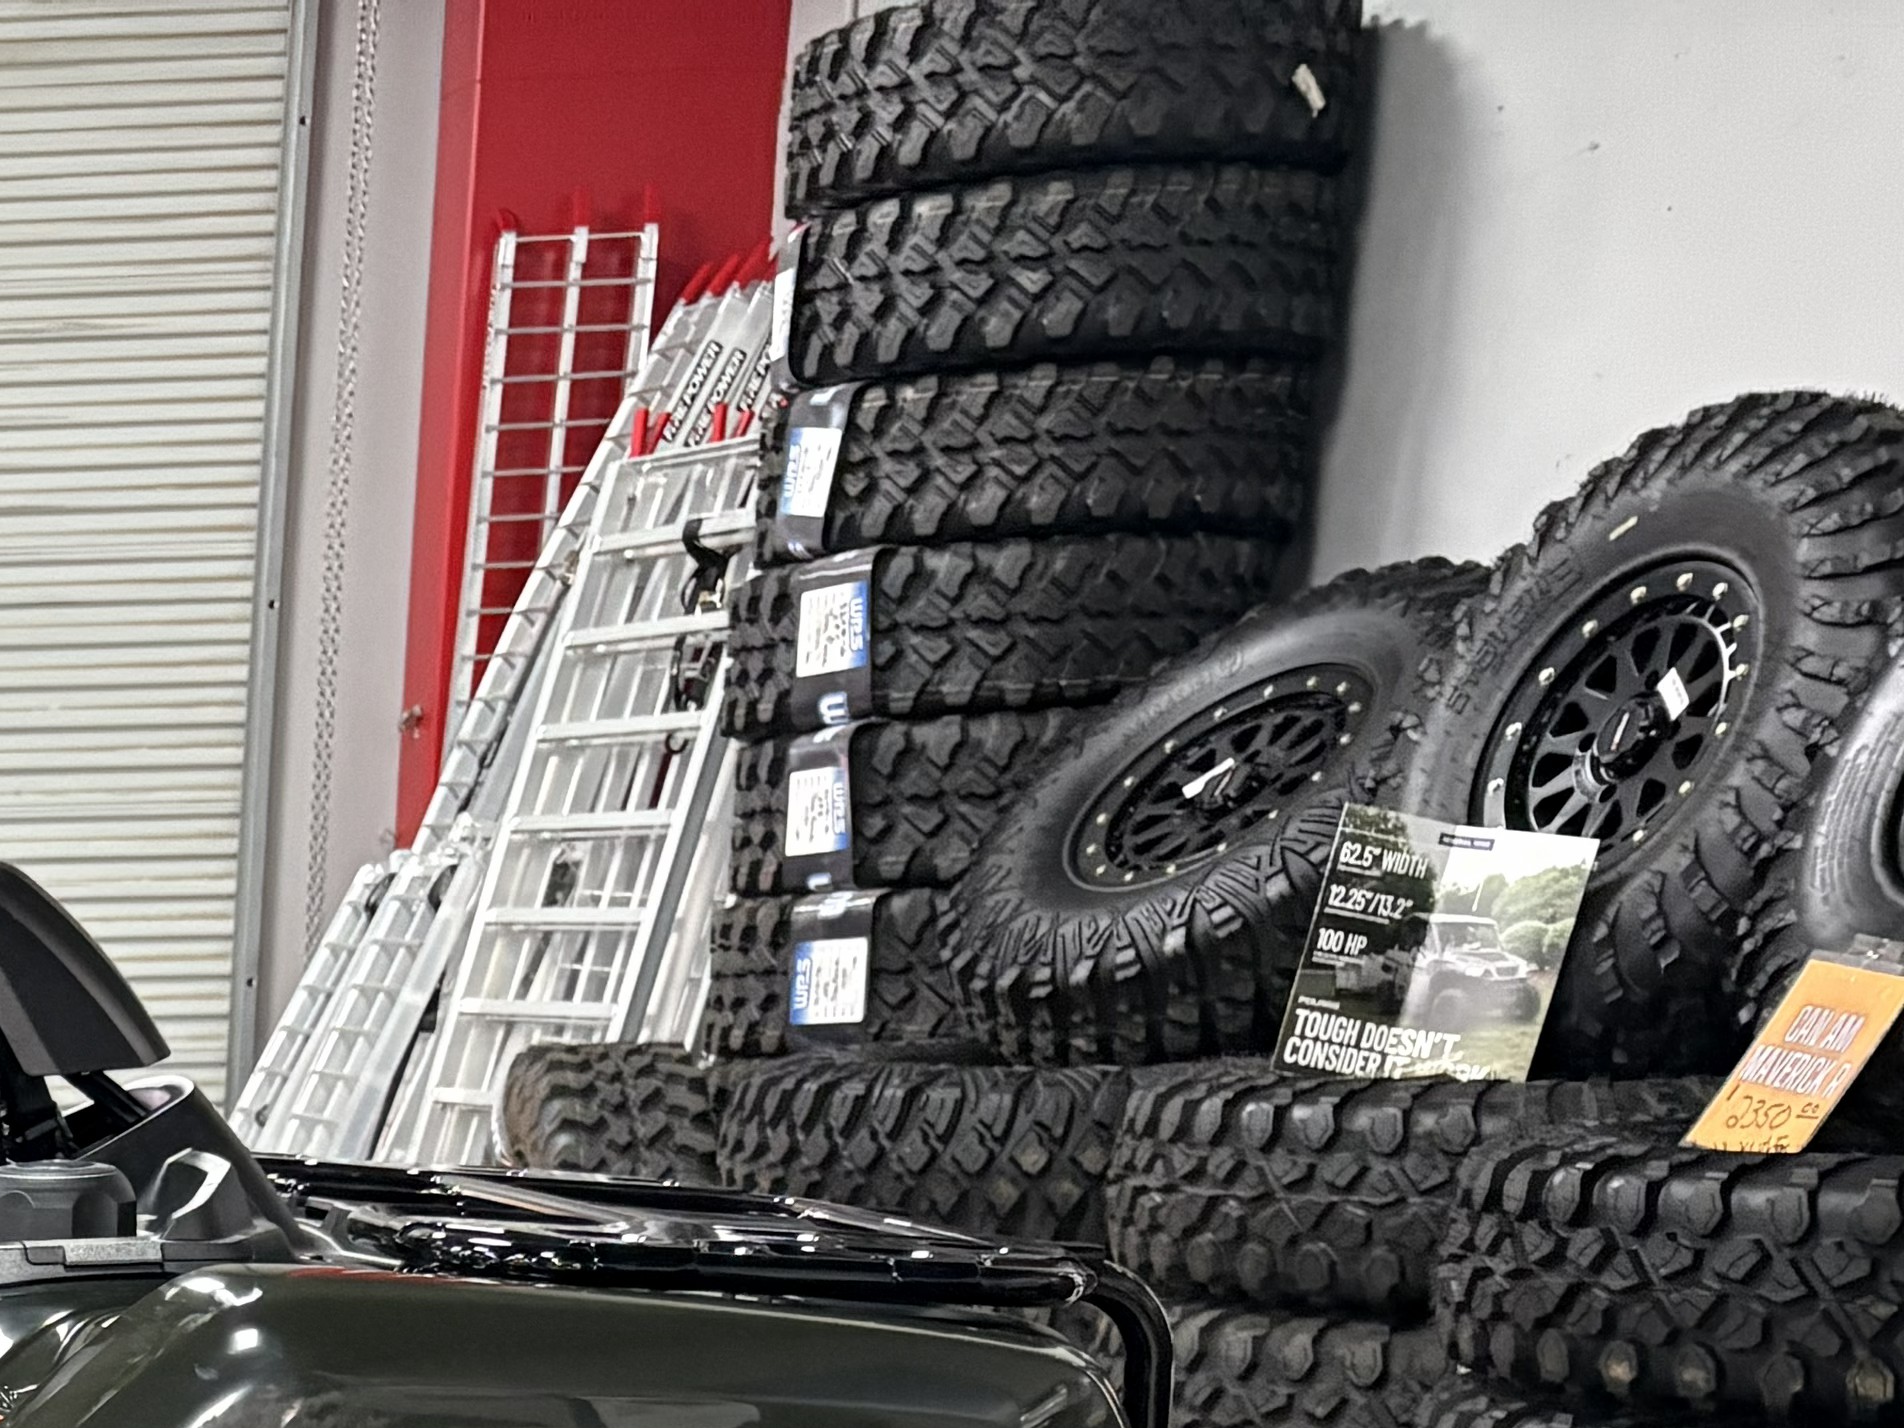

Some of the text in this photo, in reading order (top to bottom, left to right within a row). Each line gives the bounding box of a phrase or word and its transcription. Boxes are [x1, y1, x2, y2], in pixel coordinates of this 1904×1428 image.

[1381, 850, 1429, 879] WIDTH
[1316, 928, 1367, 956] 100 HP
[793, 957, 812, 1009] WPS
[1294, 1009, 1461, 1059] TOUGH DOESN'T
[1784, 1004, 1866, 1053] CAN AM
[1283, 1037, 1382, 1078] CONSIDER
[1739, 1044, 1852, 1098] MAVERICK R
